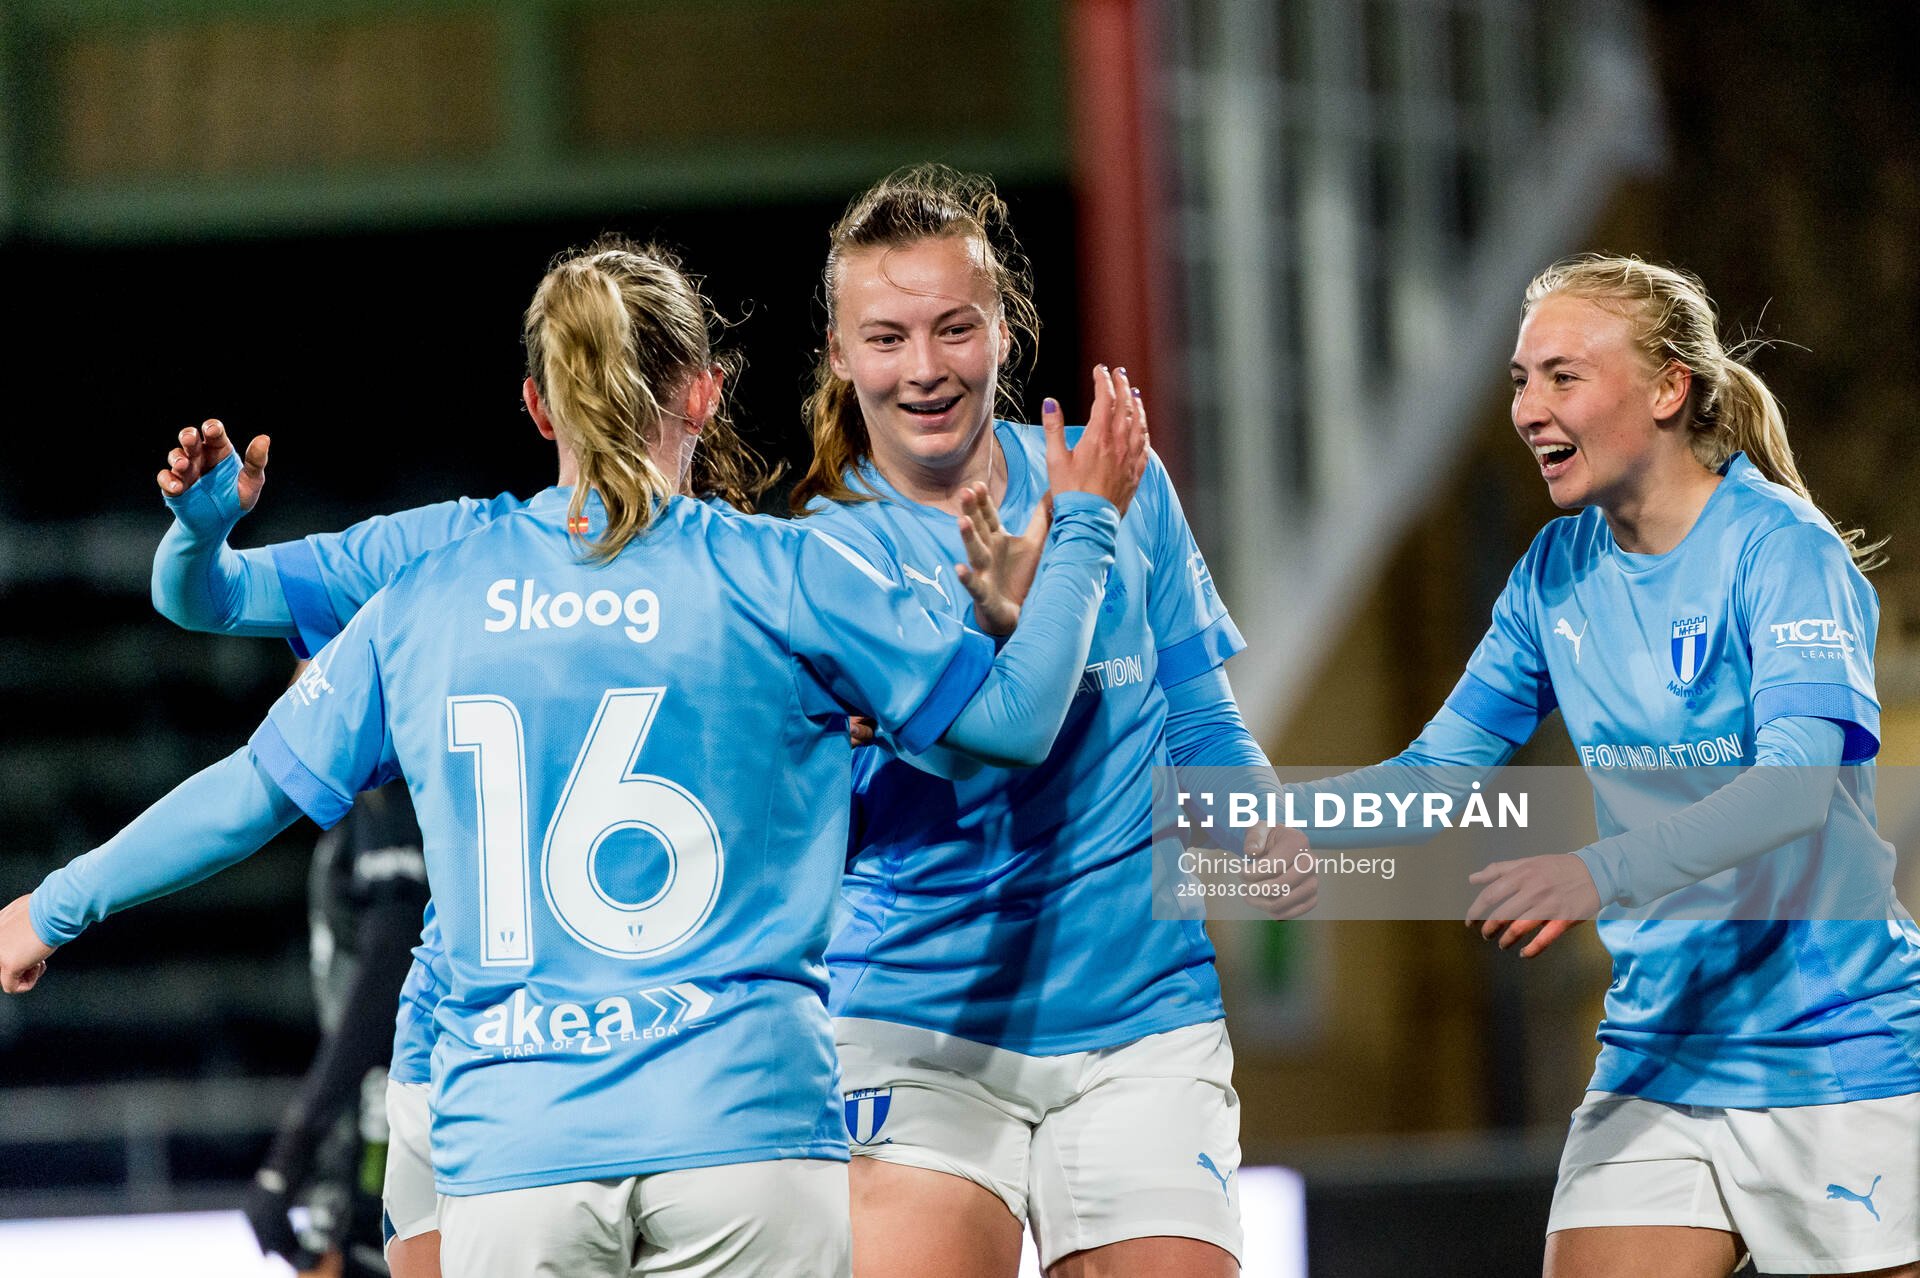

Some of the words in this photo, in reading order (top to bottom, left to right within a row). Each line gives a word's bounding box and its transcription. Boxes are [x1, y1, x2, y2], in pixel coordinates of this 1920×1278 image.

[484, 578, 661, 644] Skoog
[1770, 618, 1855, 653] TICTAC
[1076, 653, 1143, 697] ATION
[1580, 732, 1744, 773] FOUNDATION
[447, 683, 725, 967] 16
[473, 988, 636, 1046] akea
[503, 1042, 546, 1060] PART
[552, 1039, 576, 1052] OF
[620, 1023, 679, 1043] ELEDA
